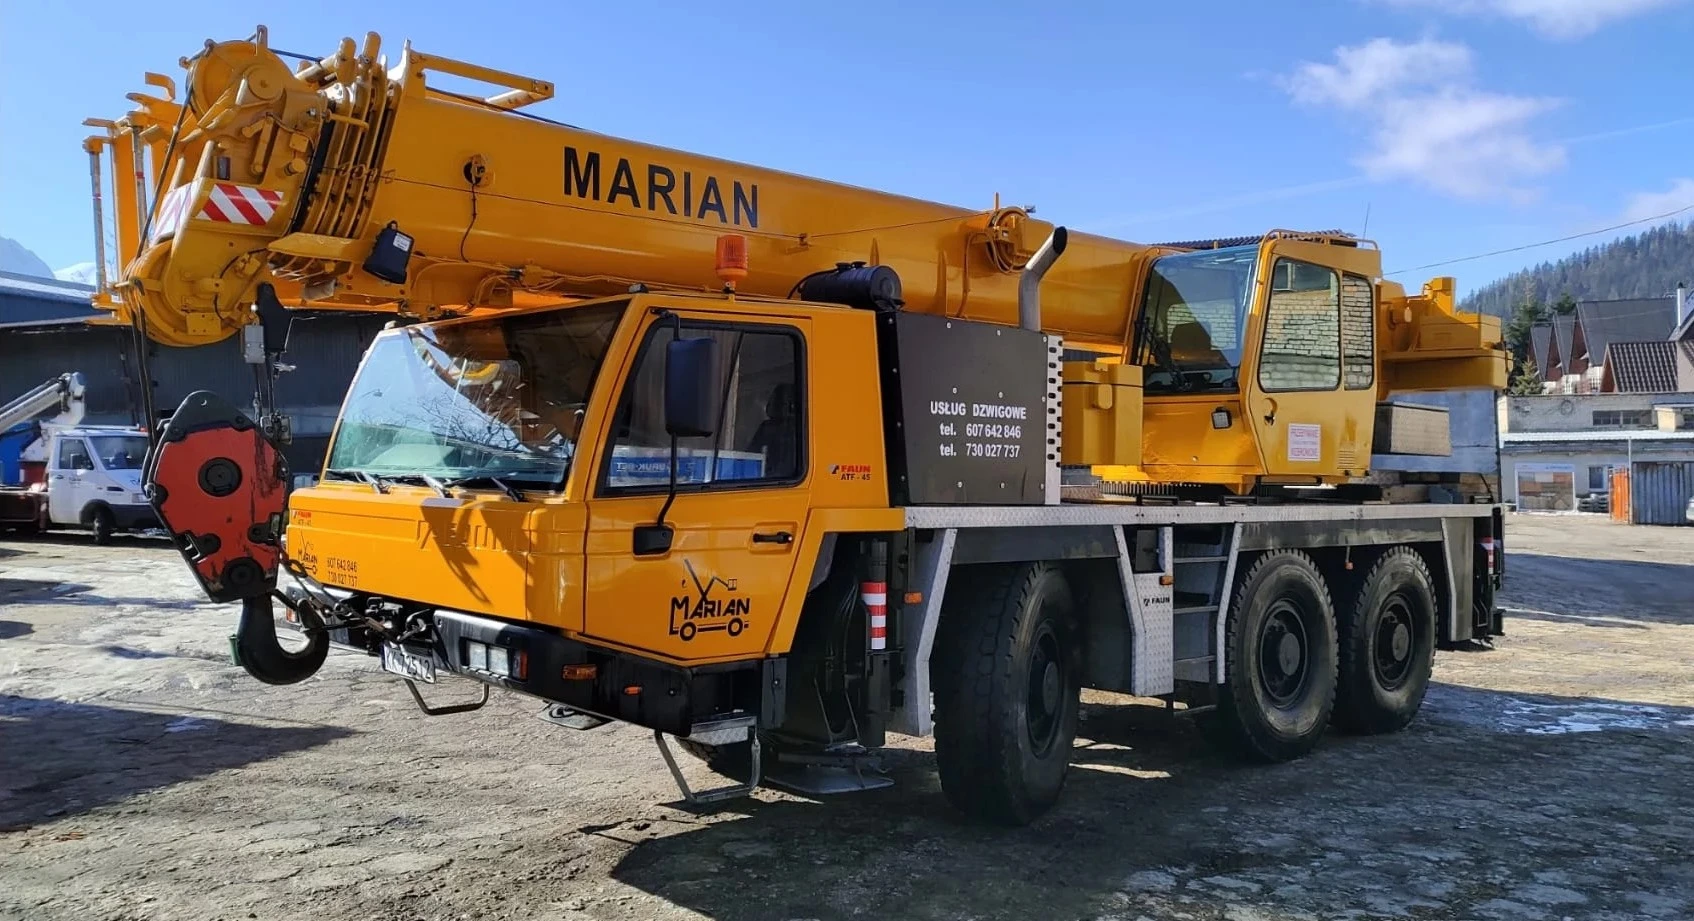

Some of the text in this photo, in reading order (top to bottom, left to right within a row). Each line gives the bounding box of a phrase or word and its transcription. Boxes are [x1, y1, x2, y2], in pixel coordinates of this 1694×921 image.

[564, 146, 758, 228] MARIAN
[940, 423, 1021, 438] tel. 607 642 846
[940, 443, 1020, 458] tel. 730 027 737
[841, 464, 871, 473] FAUN
[1151, 596, 1170, 604] FAUN
[669, 595, 751, 636] MARIAN
